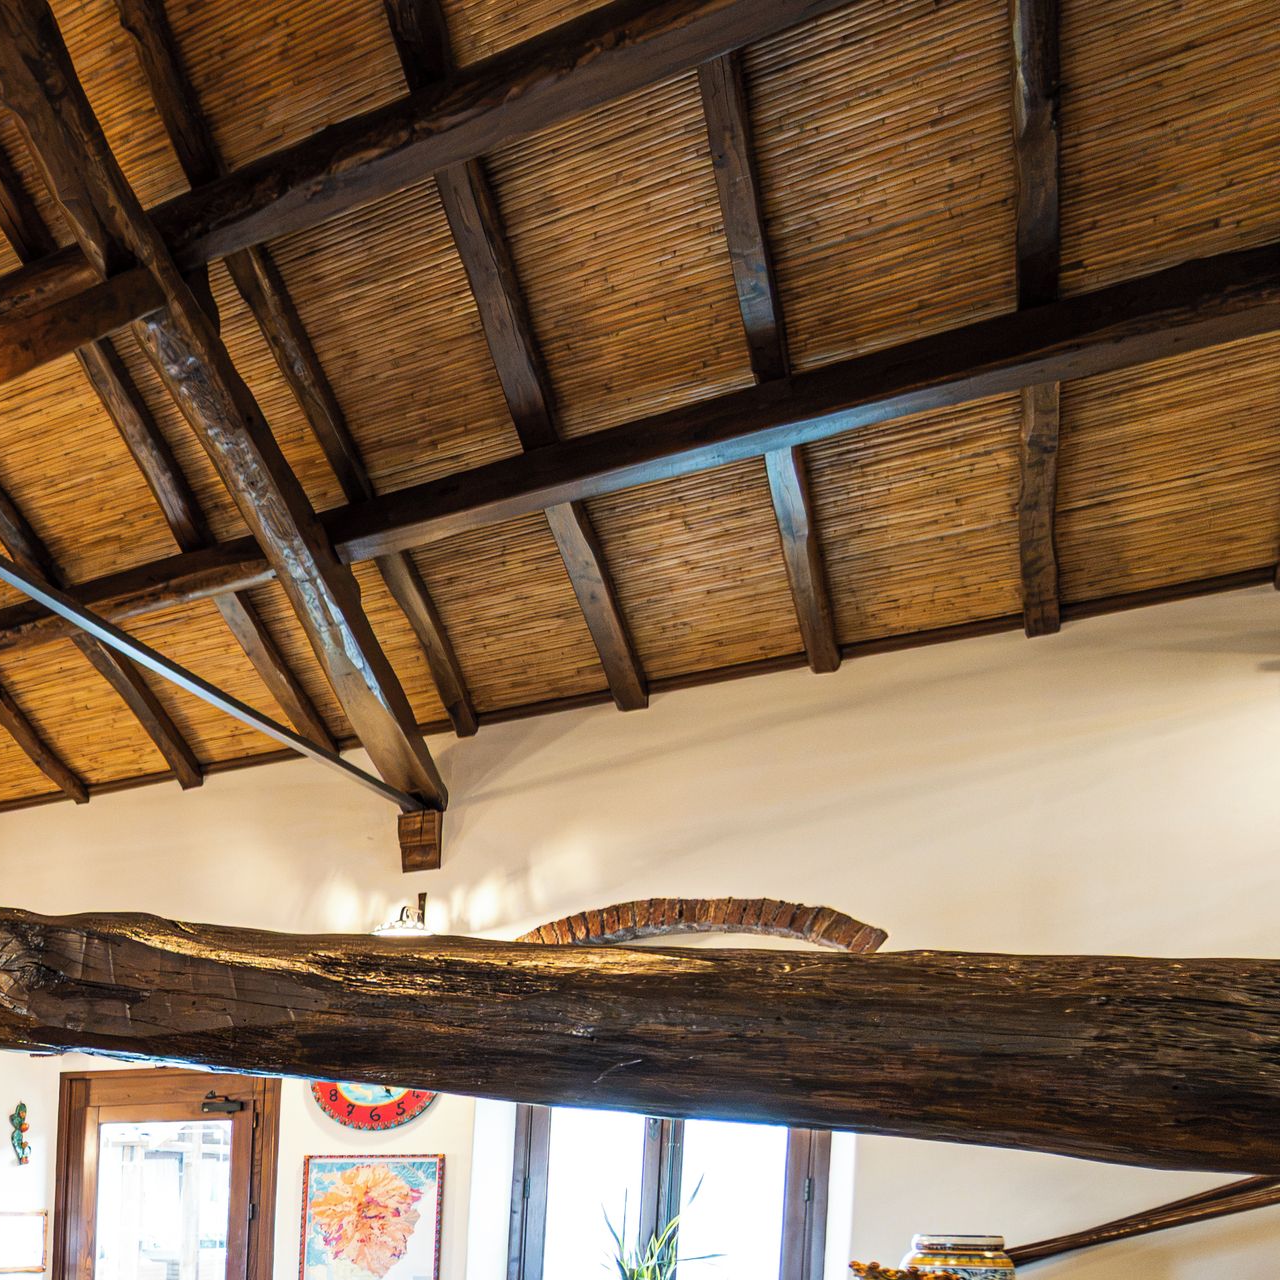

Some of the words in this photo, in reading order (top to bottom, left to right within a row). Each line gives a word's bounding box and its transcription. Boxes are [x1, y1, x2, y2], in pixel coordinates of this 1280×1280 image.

[329, 1088, 338, 1102] 8
[346, 1103, 355, 1117] 7
[369, 1107, 381, 1122] 6
[396, 1101, 406, 1116] 5
